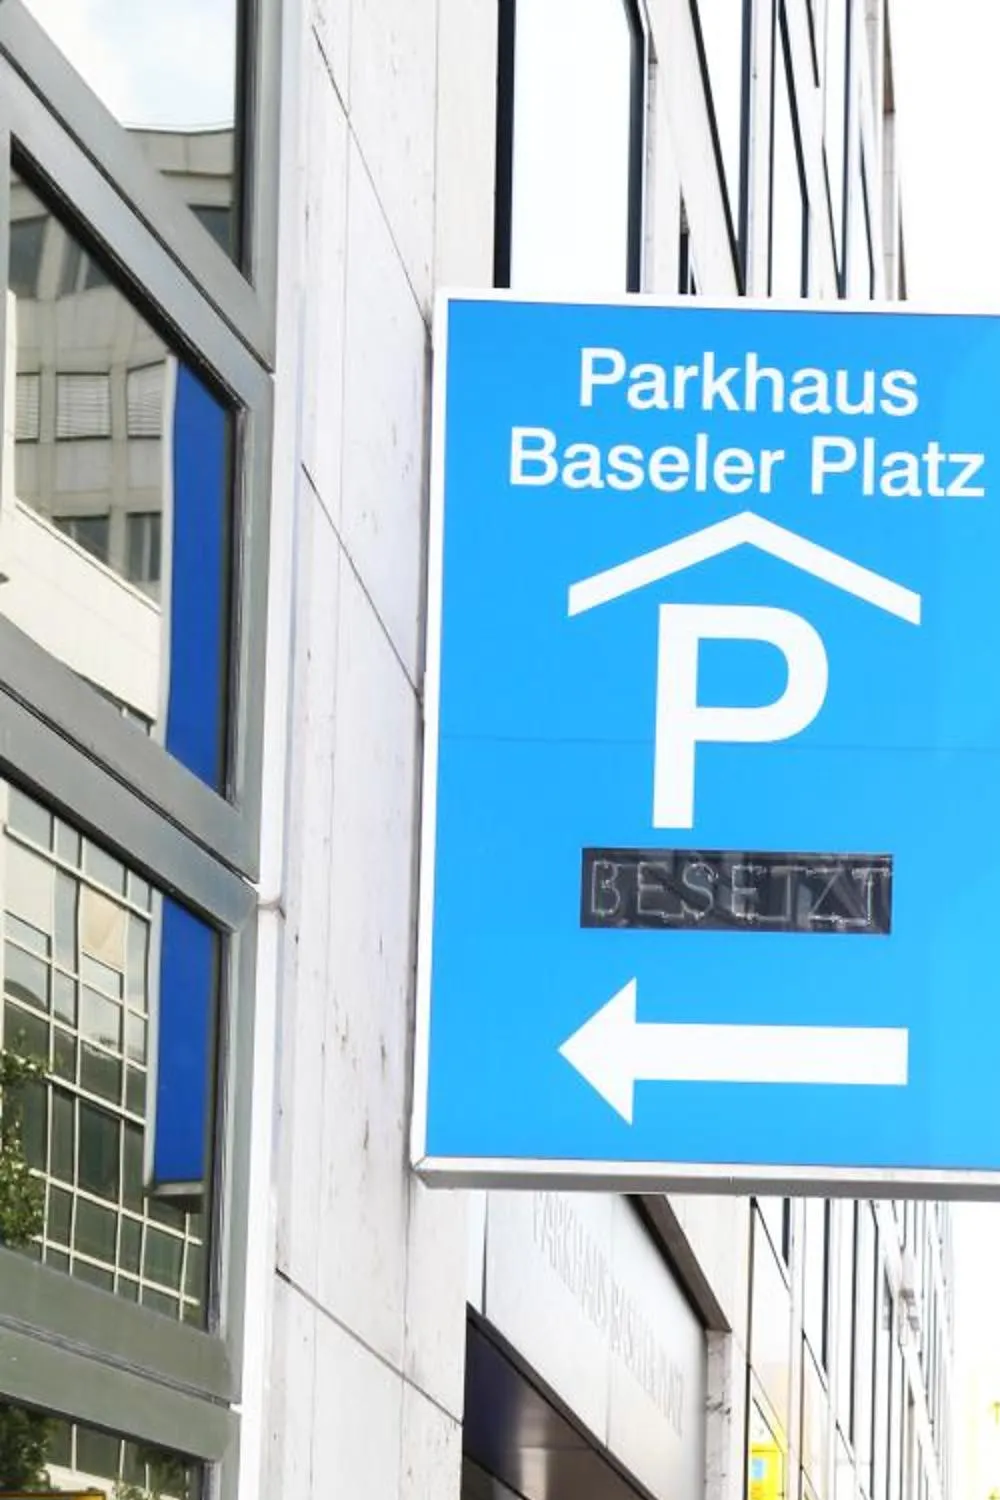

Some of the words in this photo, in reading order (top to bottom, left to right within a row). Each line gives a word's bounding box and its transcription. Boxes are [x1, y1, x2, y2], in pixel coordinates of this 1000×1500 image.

[579, 347, 920, 416] Parkhaus
[509, 426, 785, 494] Baseler
[811, 436, 986, 498] Platz
[653, 603, 829, 829] P
